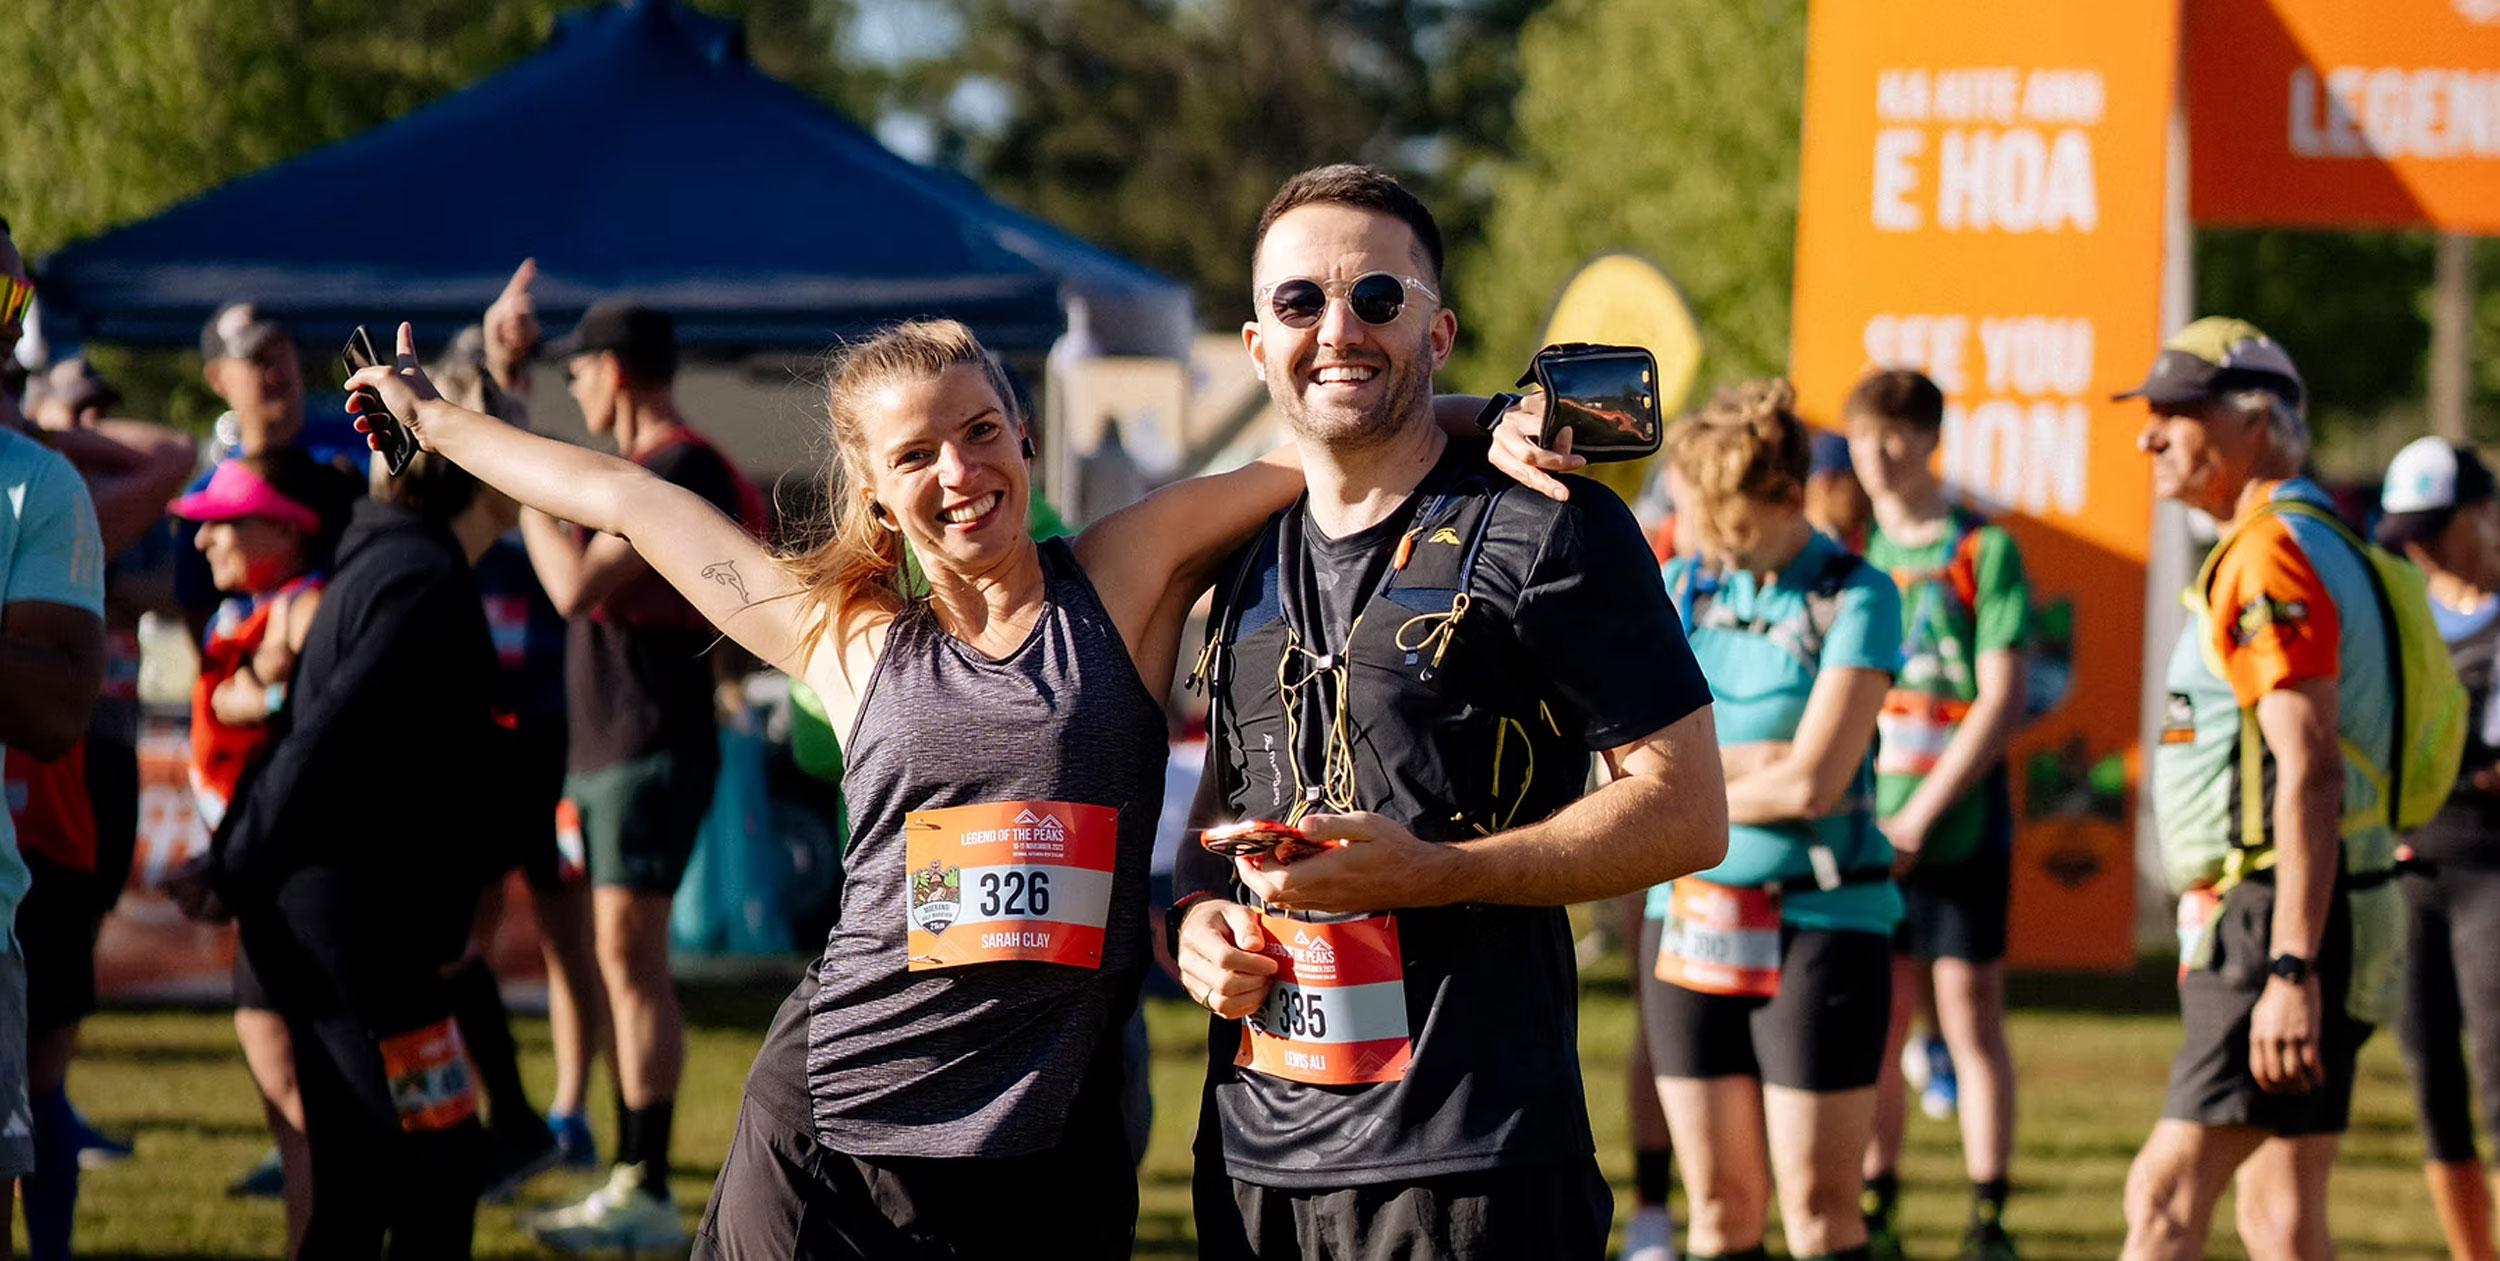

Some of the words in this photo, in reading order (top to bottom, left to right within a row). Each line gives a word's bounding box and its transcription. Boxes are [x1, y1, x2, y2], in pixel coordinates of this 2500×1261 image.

[1872, 128, 1926, 232] E
[1937, 128, 2099, 233] HOA
[1979, 317, 2093, 395] YOU
[960, 830, 997, 846] LEGEND
[998, 829, 1010, 842] OF
[1012, 828, 1032, 841] THE
[1034, 829, 1064, 842] PEAKS
[979, 871, 1050, 918] 326
[981, 932, 1020, 949] SARAH
[1023, 932, 1051, 949] CLAY
[1306, 949, 1335, 964] PEAKS
